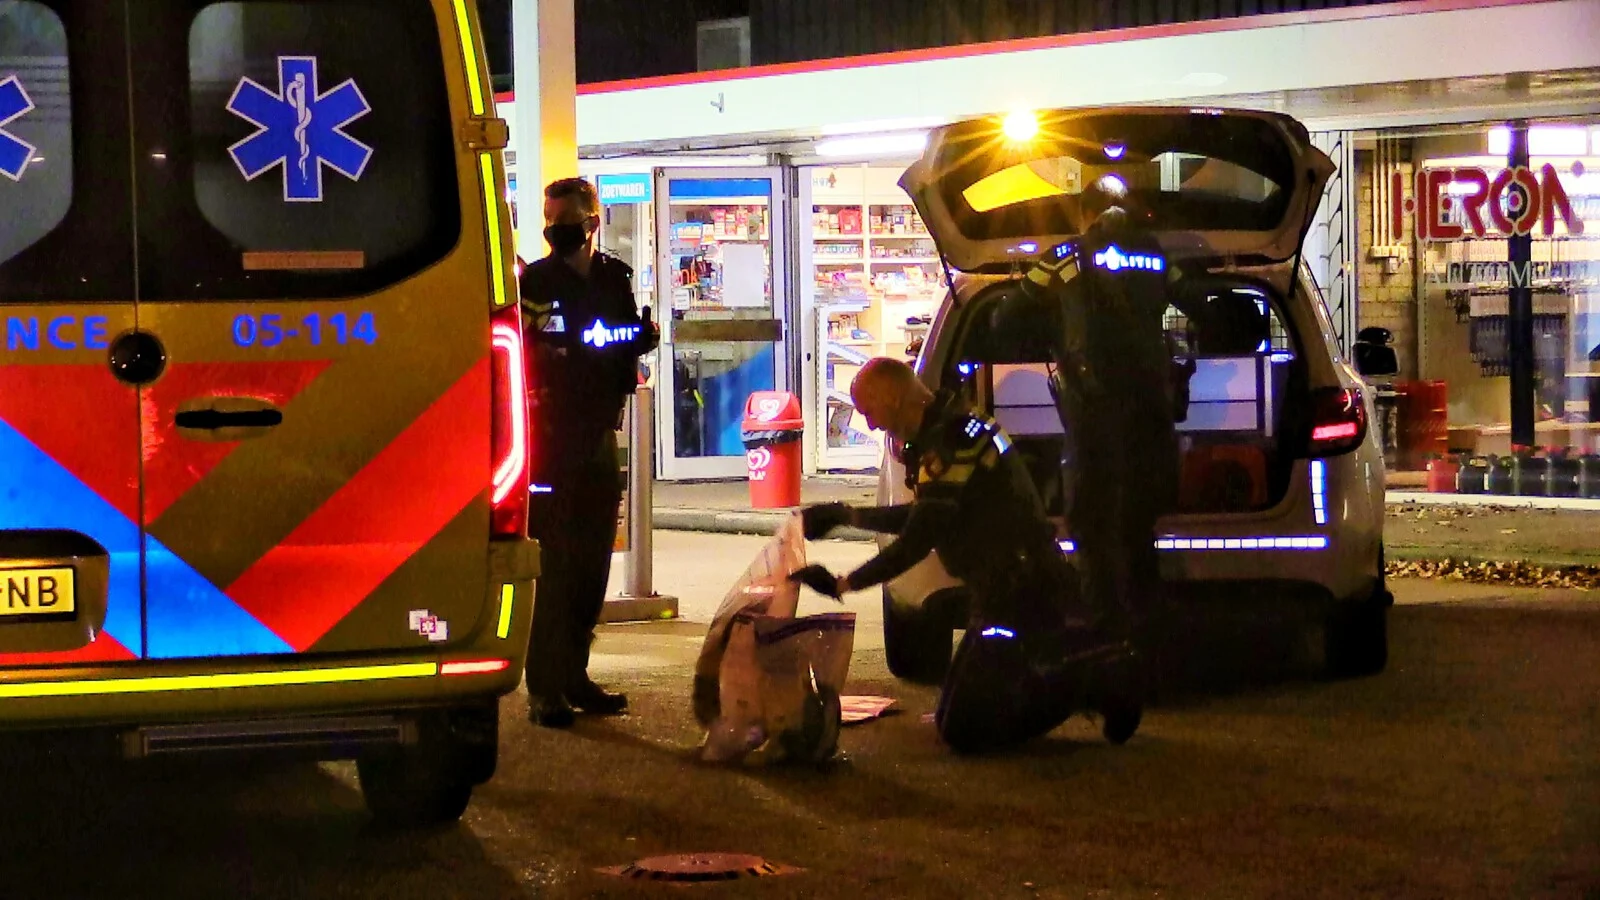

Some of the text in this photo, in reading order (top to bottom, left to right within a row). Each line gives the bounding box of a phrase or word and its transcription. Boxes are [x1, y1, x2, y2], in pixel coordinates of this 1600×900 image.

[1392, 162, 1585, 240] HERON
[7, 315, 109, 350] NCE
[232, 312, 378, 347] 05-114
